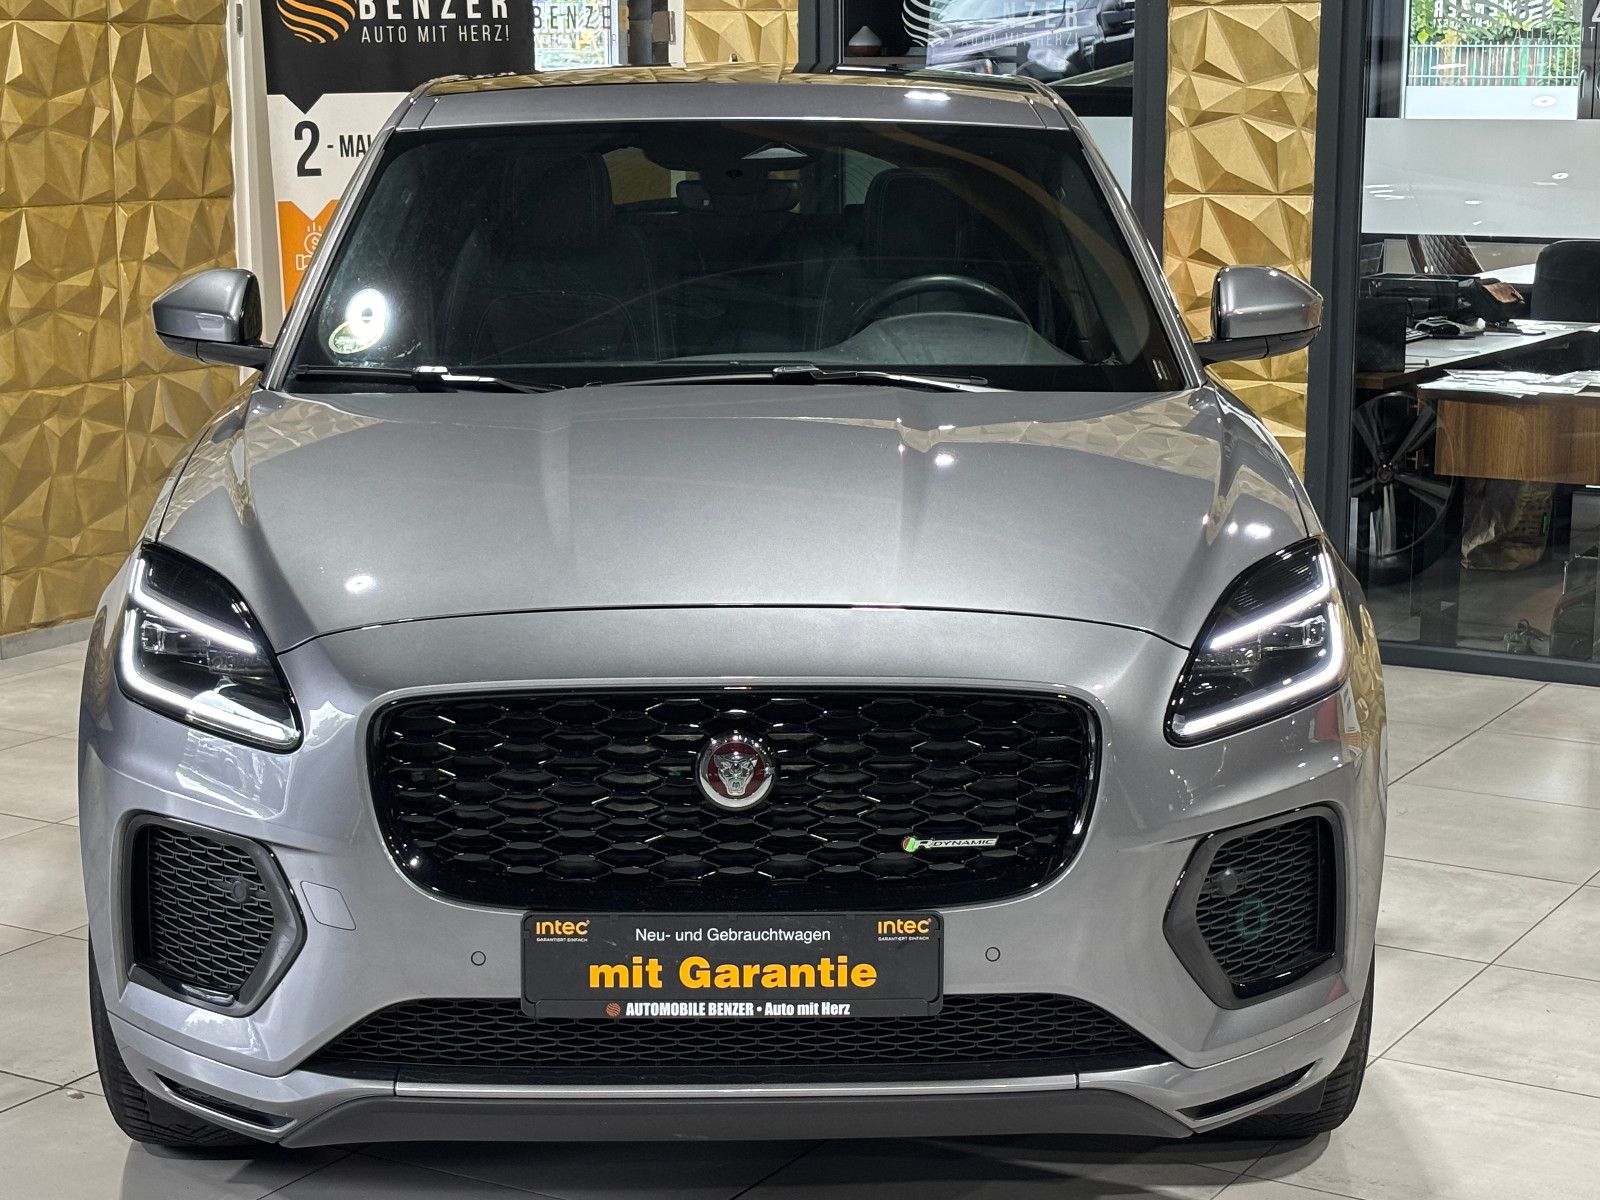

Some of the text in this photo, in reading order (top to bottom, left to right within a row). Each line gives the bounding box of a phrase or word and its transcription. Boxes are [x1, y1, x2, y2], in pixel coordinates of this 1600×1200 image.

[361, 24, 510, 43] AUTO MIT HERZ!
[294, 120, 322, 177] 2
[635, 927, 831, 944] Neu- und Gebrauchtwagen
[589, 955, 878, 989] mit Garantie
[625, 1001, 851, 1017] AUTOMOBILE BENZER Auto mit Herz
